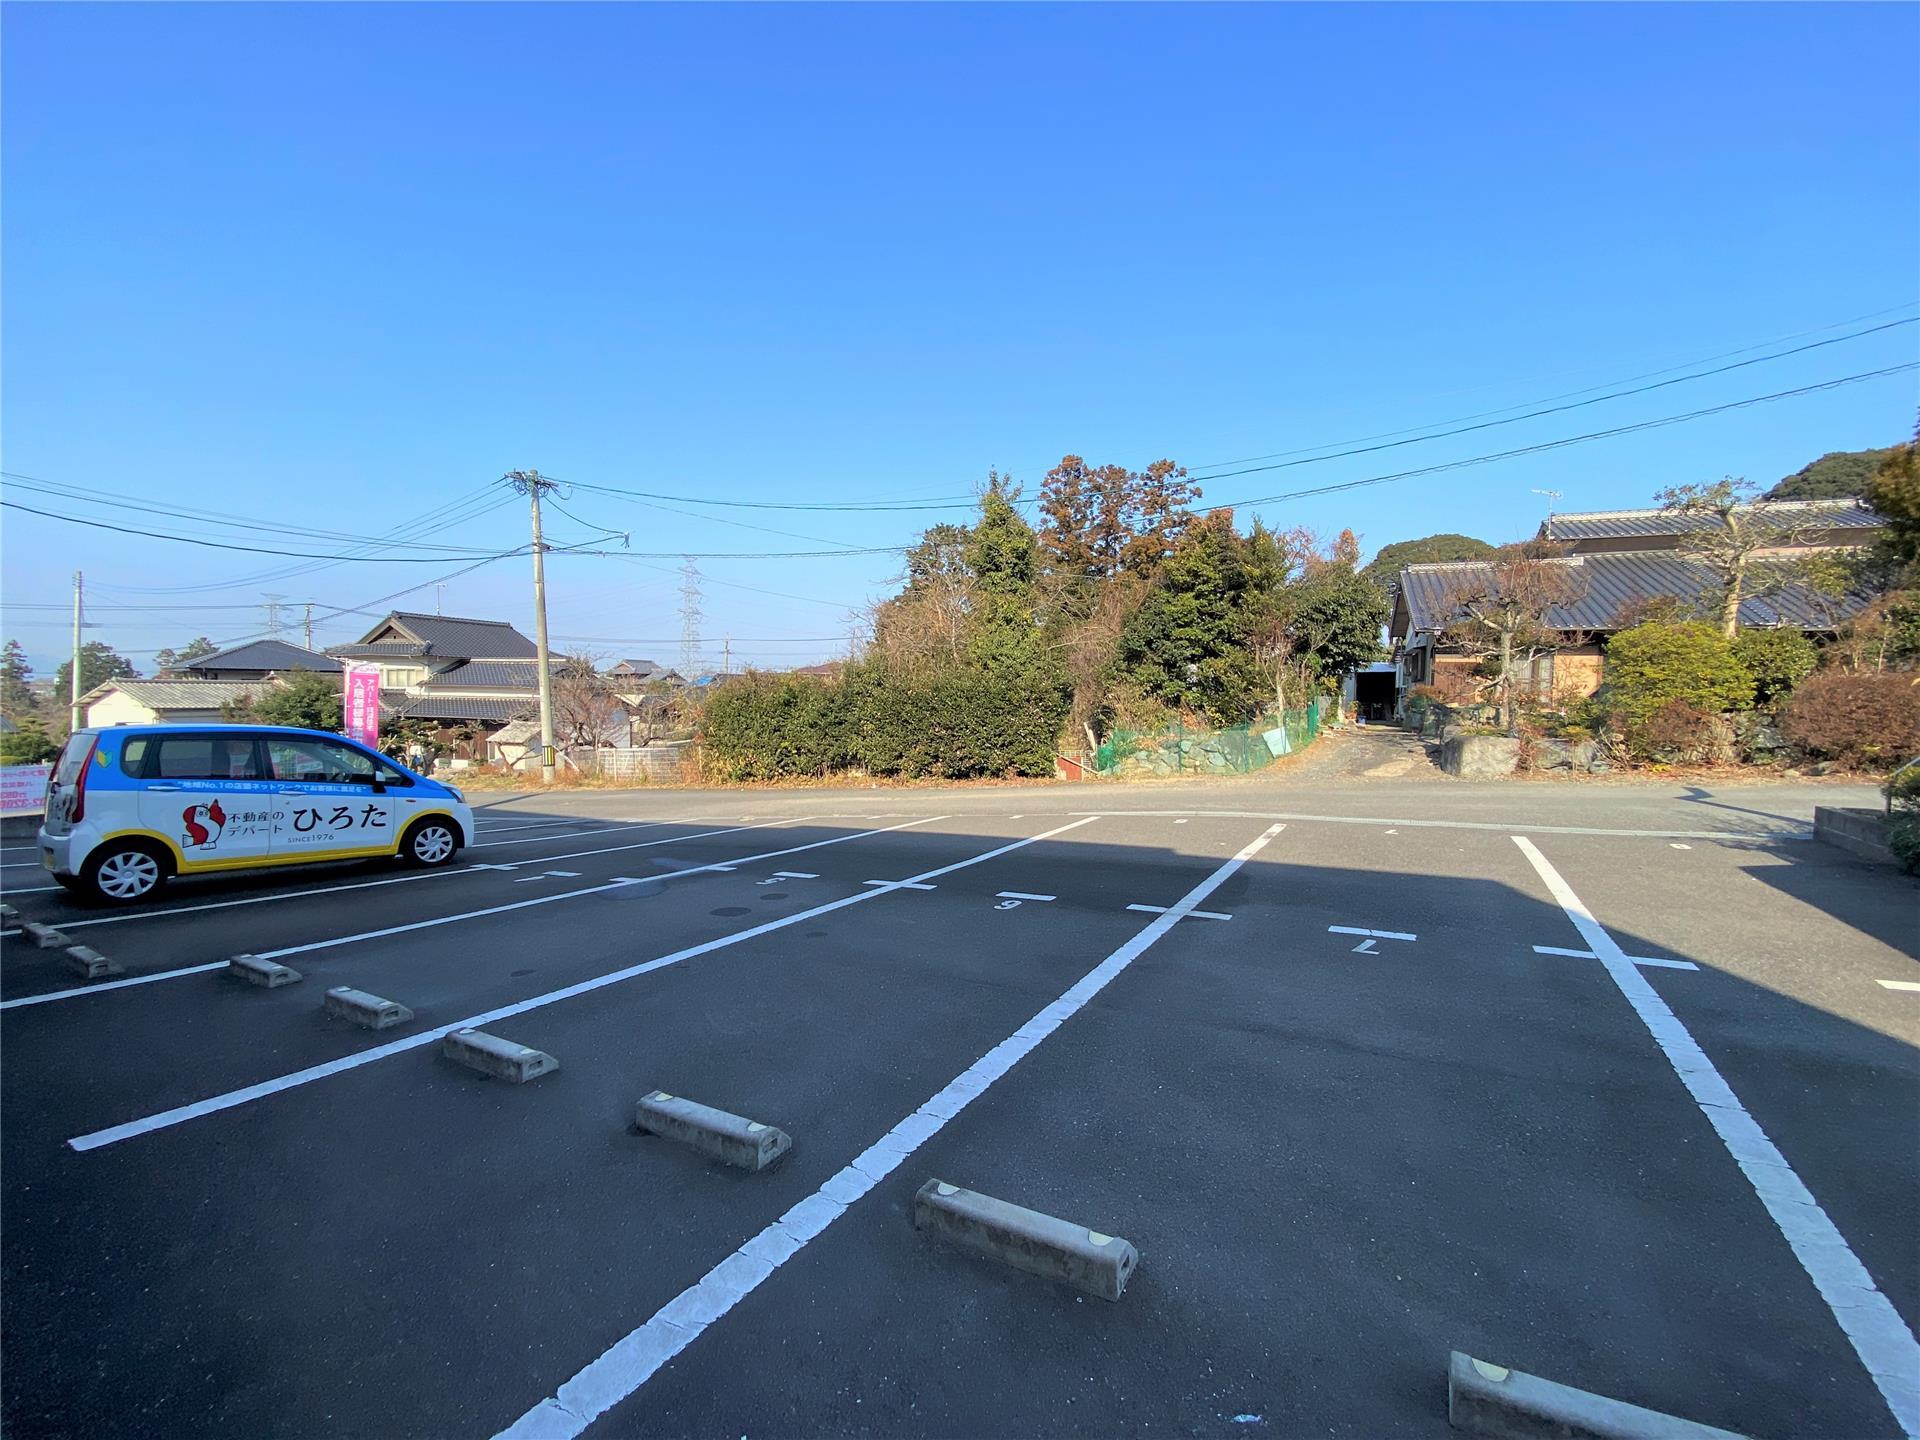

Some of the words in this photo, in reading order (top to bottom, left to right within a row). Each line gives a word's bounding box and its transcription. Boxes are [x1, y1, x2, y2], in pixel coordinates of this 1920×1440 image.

[228, 811, 285, 824] 不動産の
[293, 804, 388, 832] ひろた
